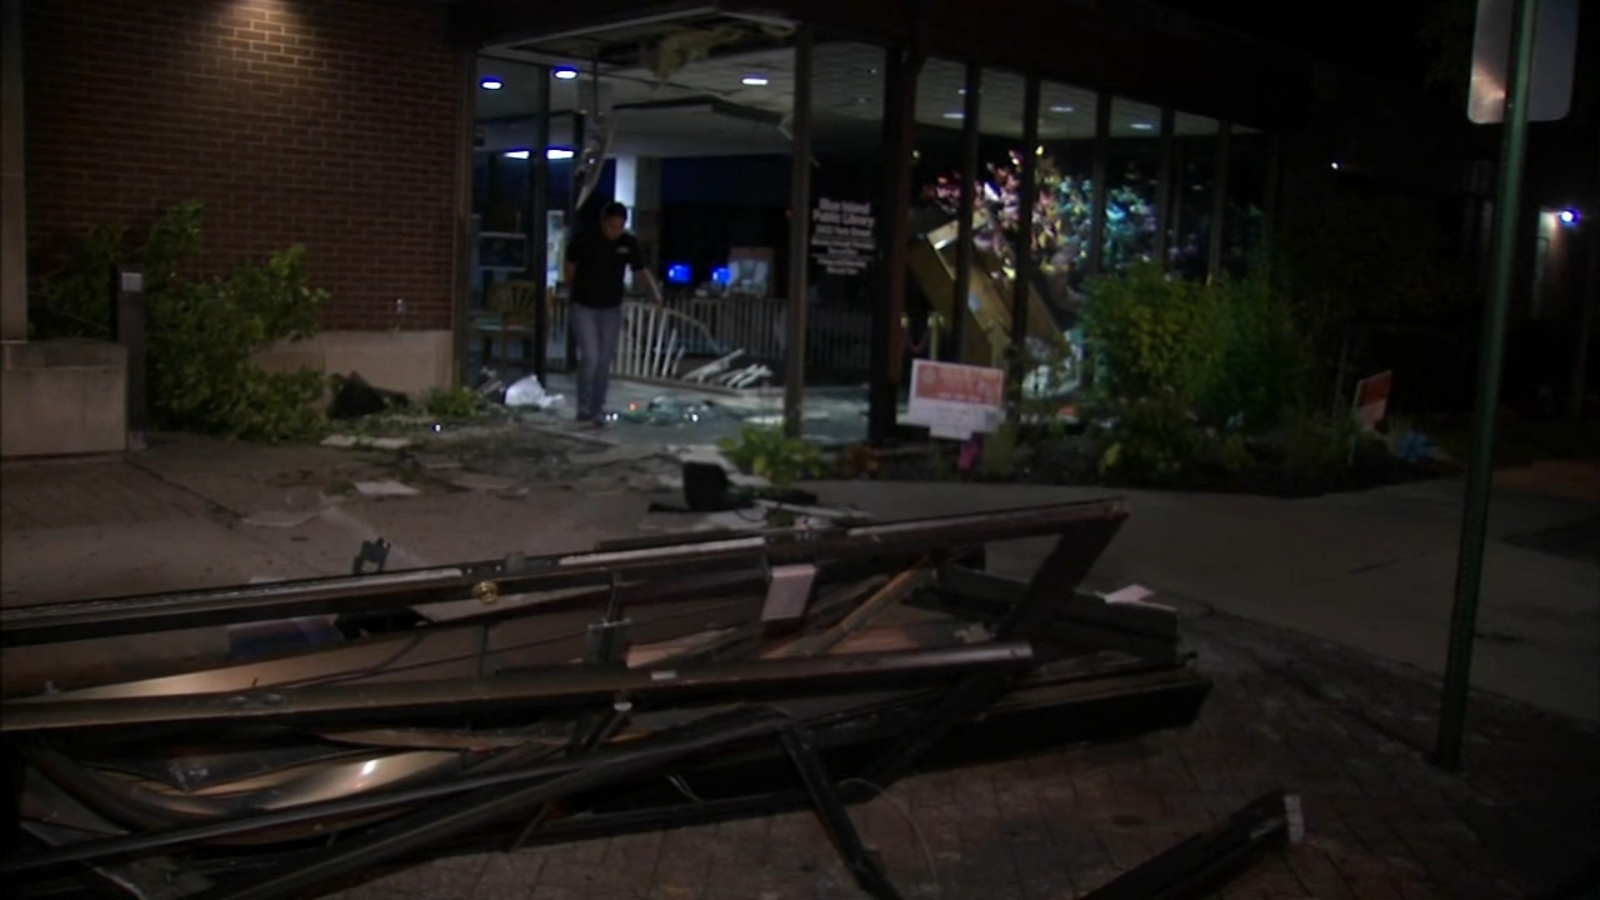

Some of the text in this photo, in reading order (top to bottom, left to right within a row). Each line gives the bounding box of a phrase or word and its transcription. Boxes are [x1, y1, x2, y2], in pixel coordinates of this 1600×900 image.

[841, 200, 871, 214] Island
[813, 209, 875, 228] Public Library
